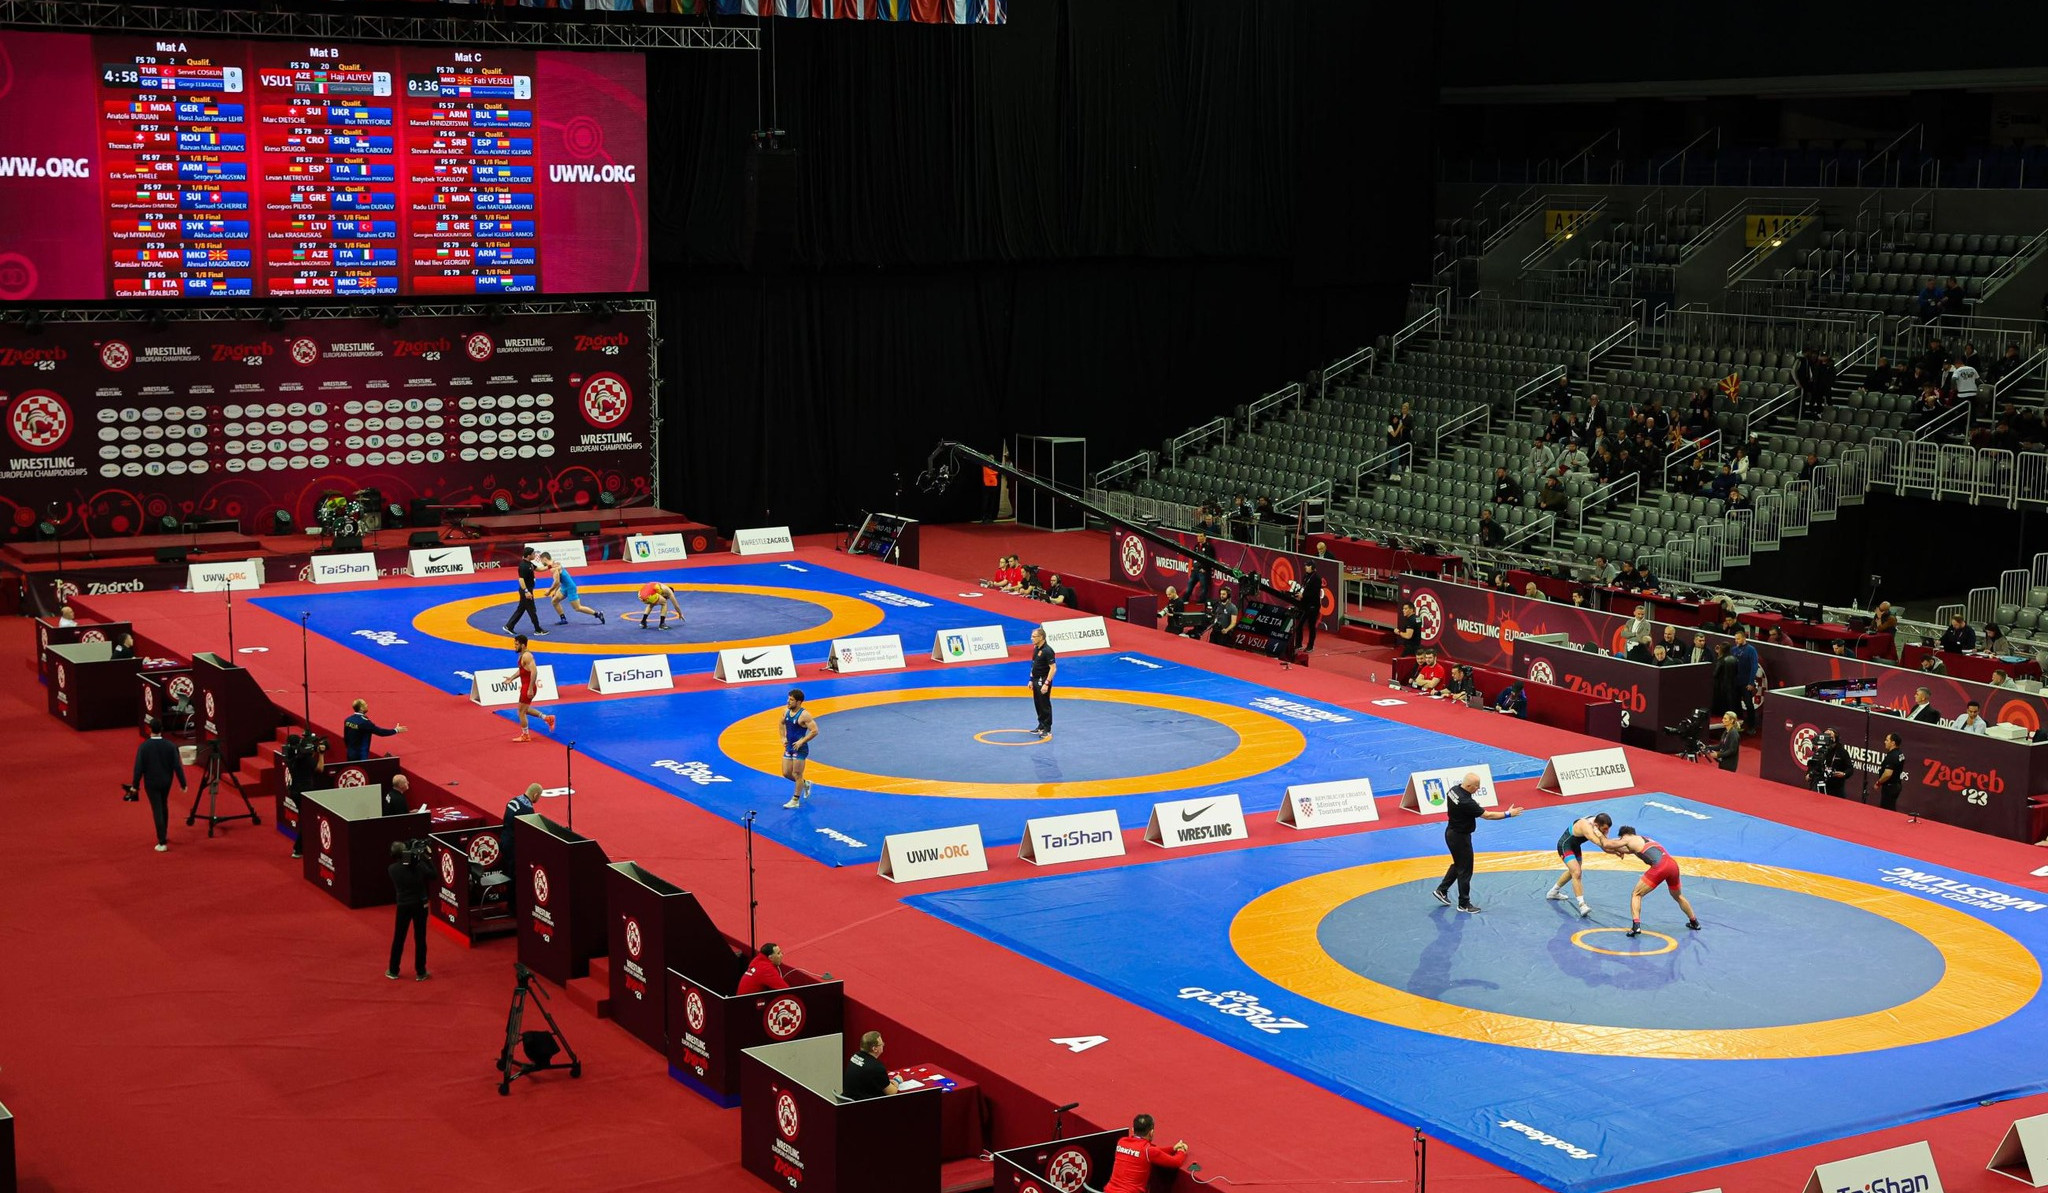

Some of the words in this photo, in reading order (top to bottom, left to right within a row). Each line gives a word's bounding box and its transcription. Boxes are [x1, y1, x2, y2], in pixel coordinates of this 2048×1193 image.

[157, 42, 176, 52] Mat
[178, 43, 187, 52] A
[310, 48, 328, 57] Mat
[331, 49, 338, 57] B
[455, 53, 472, 62] Mat
[474, 54, 482, 62] C
[105, 71, 138, 82] 4:58
[261, 76, 292, 86] VSU1
[330, 73, 344, 82] Haji
[409, 80, 438, 91] 0:36
[549, 165, 635, 182] UWW.ORG
[1555, 213, 1563, 230] A
[1756, 218, 1766, 237] A
[332, 342, 374, 352] WRESTLING
[393, 338, 450, 356] Zagreb
[505, 338, 545, 346] WRESTLING
[574, 332, 629, 352] Zagreb
[1, 346, 68, 366] Zagreb
[145, 346, 192, 356] WRESTLING
[211, 341, 274, 362] Zagreb
[581, 433, 632, 444] WRESTLING
[570, 444, 599, 452] EUROPEAN
[600, 442, 642, 451] CHAMPIONSHIPS
[10, 457, 74, 470] WRESTLING
[0, 470, 33, 480] EUROPEAN
[35, 468, 88, 477] CHAMPIONSHIPS
[740, 537, 790, 547] #WRESTLEZAGREB
[658, 546, 680, 554] ZAGREB
[320, 564, 369, 575] TaiShan
[425, 564, 463, 573] WRESTLING
[1156, 556, 1189, 573] WRESTLING
[203, 573, 246, 582] UWW.ORG
[87, 579, 144, 595] Zagreb
[1456, 618, 1500, 638] WRESTLING
[1048, 629, 1104, 642] #WRESTLEZAGREB
[1235, 634, 1246, 644] 12
[974, 643, 1000, 652] ZAGREB
[605, 668, 663, 683] TaiShan
[737, 666, 783, 680] WRESTLING
[1559, 764, 1626, 781] #WRESTLEZAGREB
[1923, 757, 2004, 794] Zagreb
[1178, 823, 1232, 842] WRESTLING
[1041, 830, 1112, 850] TaiShan
[907, 844, 969, 864] UWW.ORG
[1881, 876, 1941, 895] WORLD
[1889, 868, 2048, 912] WRESTLING
[1941, 893, 2006, 912] UNITED
[1177, 987, 1309, 1034] Zagreb
[1049, 1035, 1109, 1053] A
[776, 1138, 800, 1160] WRESTLING
